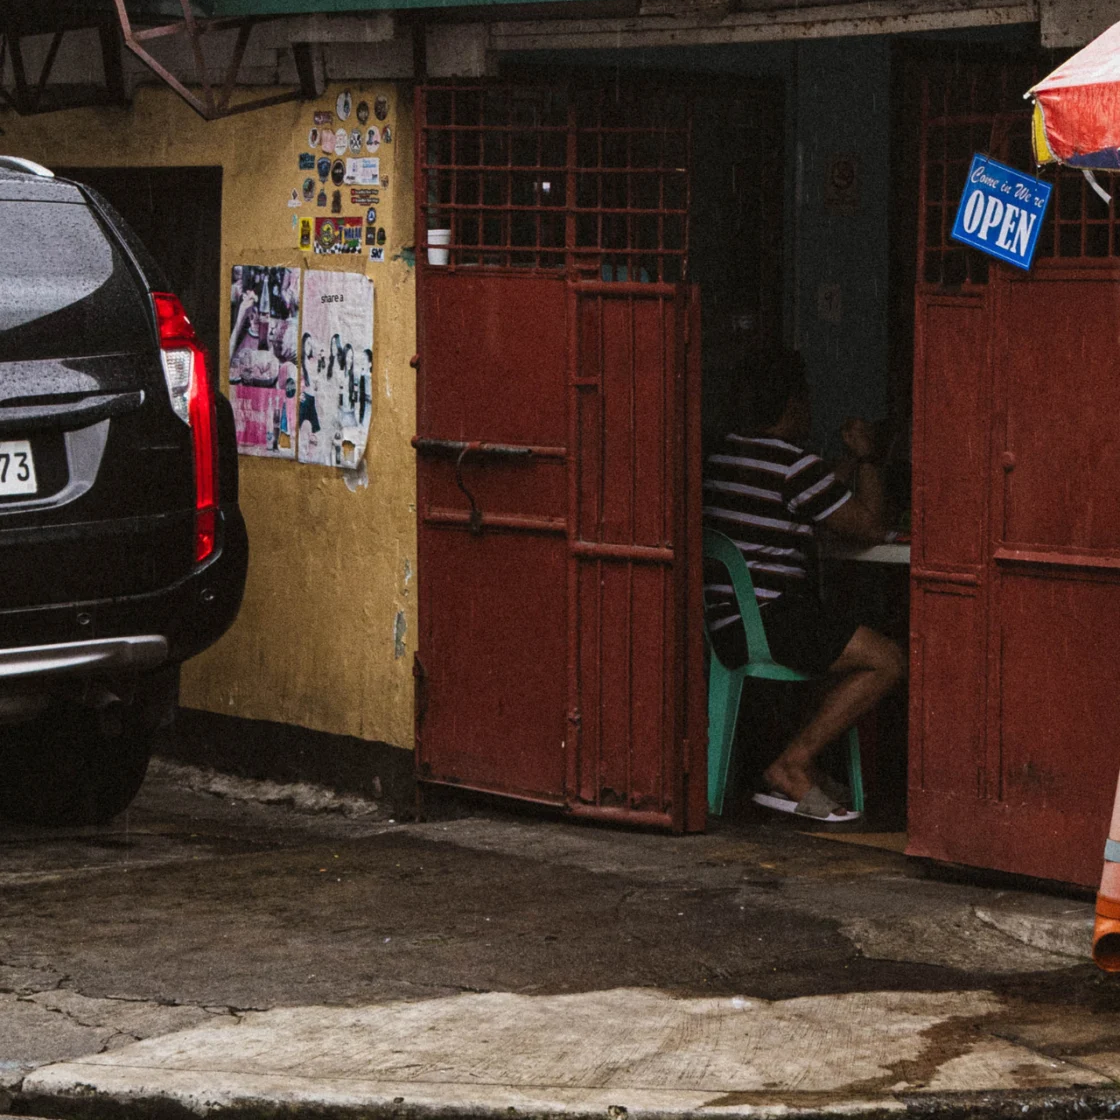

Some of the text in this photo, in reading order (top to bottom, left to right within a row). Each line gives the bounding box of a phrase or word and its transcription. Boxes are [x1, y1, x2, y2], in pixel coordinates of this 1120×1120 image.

[970, 165, 1000, 189] Come
[1000, 180, 1012, 194] in
[963, 189, 1037, 258] OPEN
[321, 294, 340, 304] share
